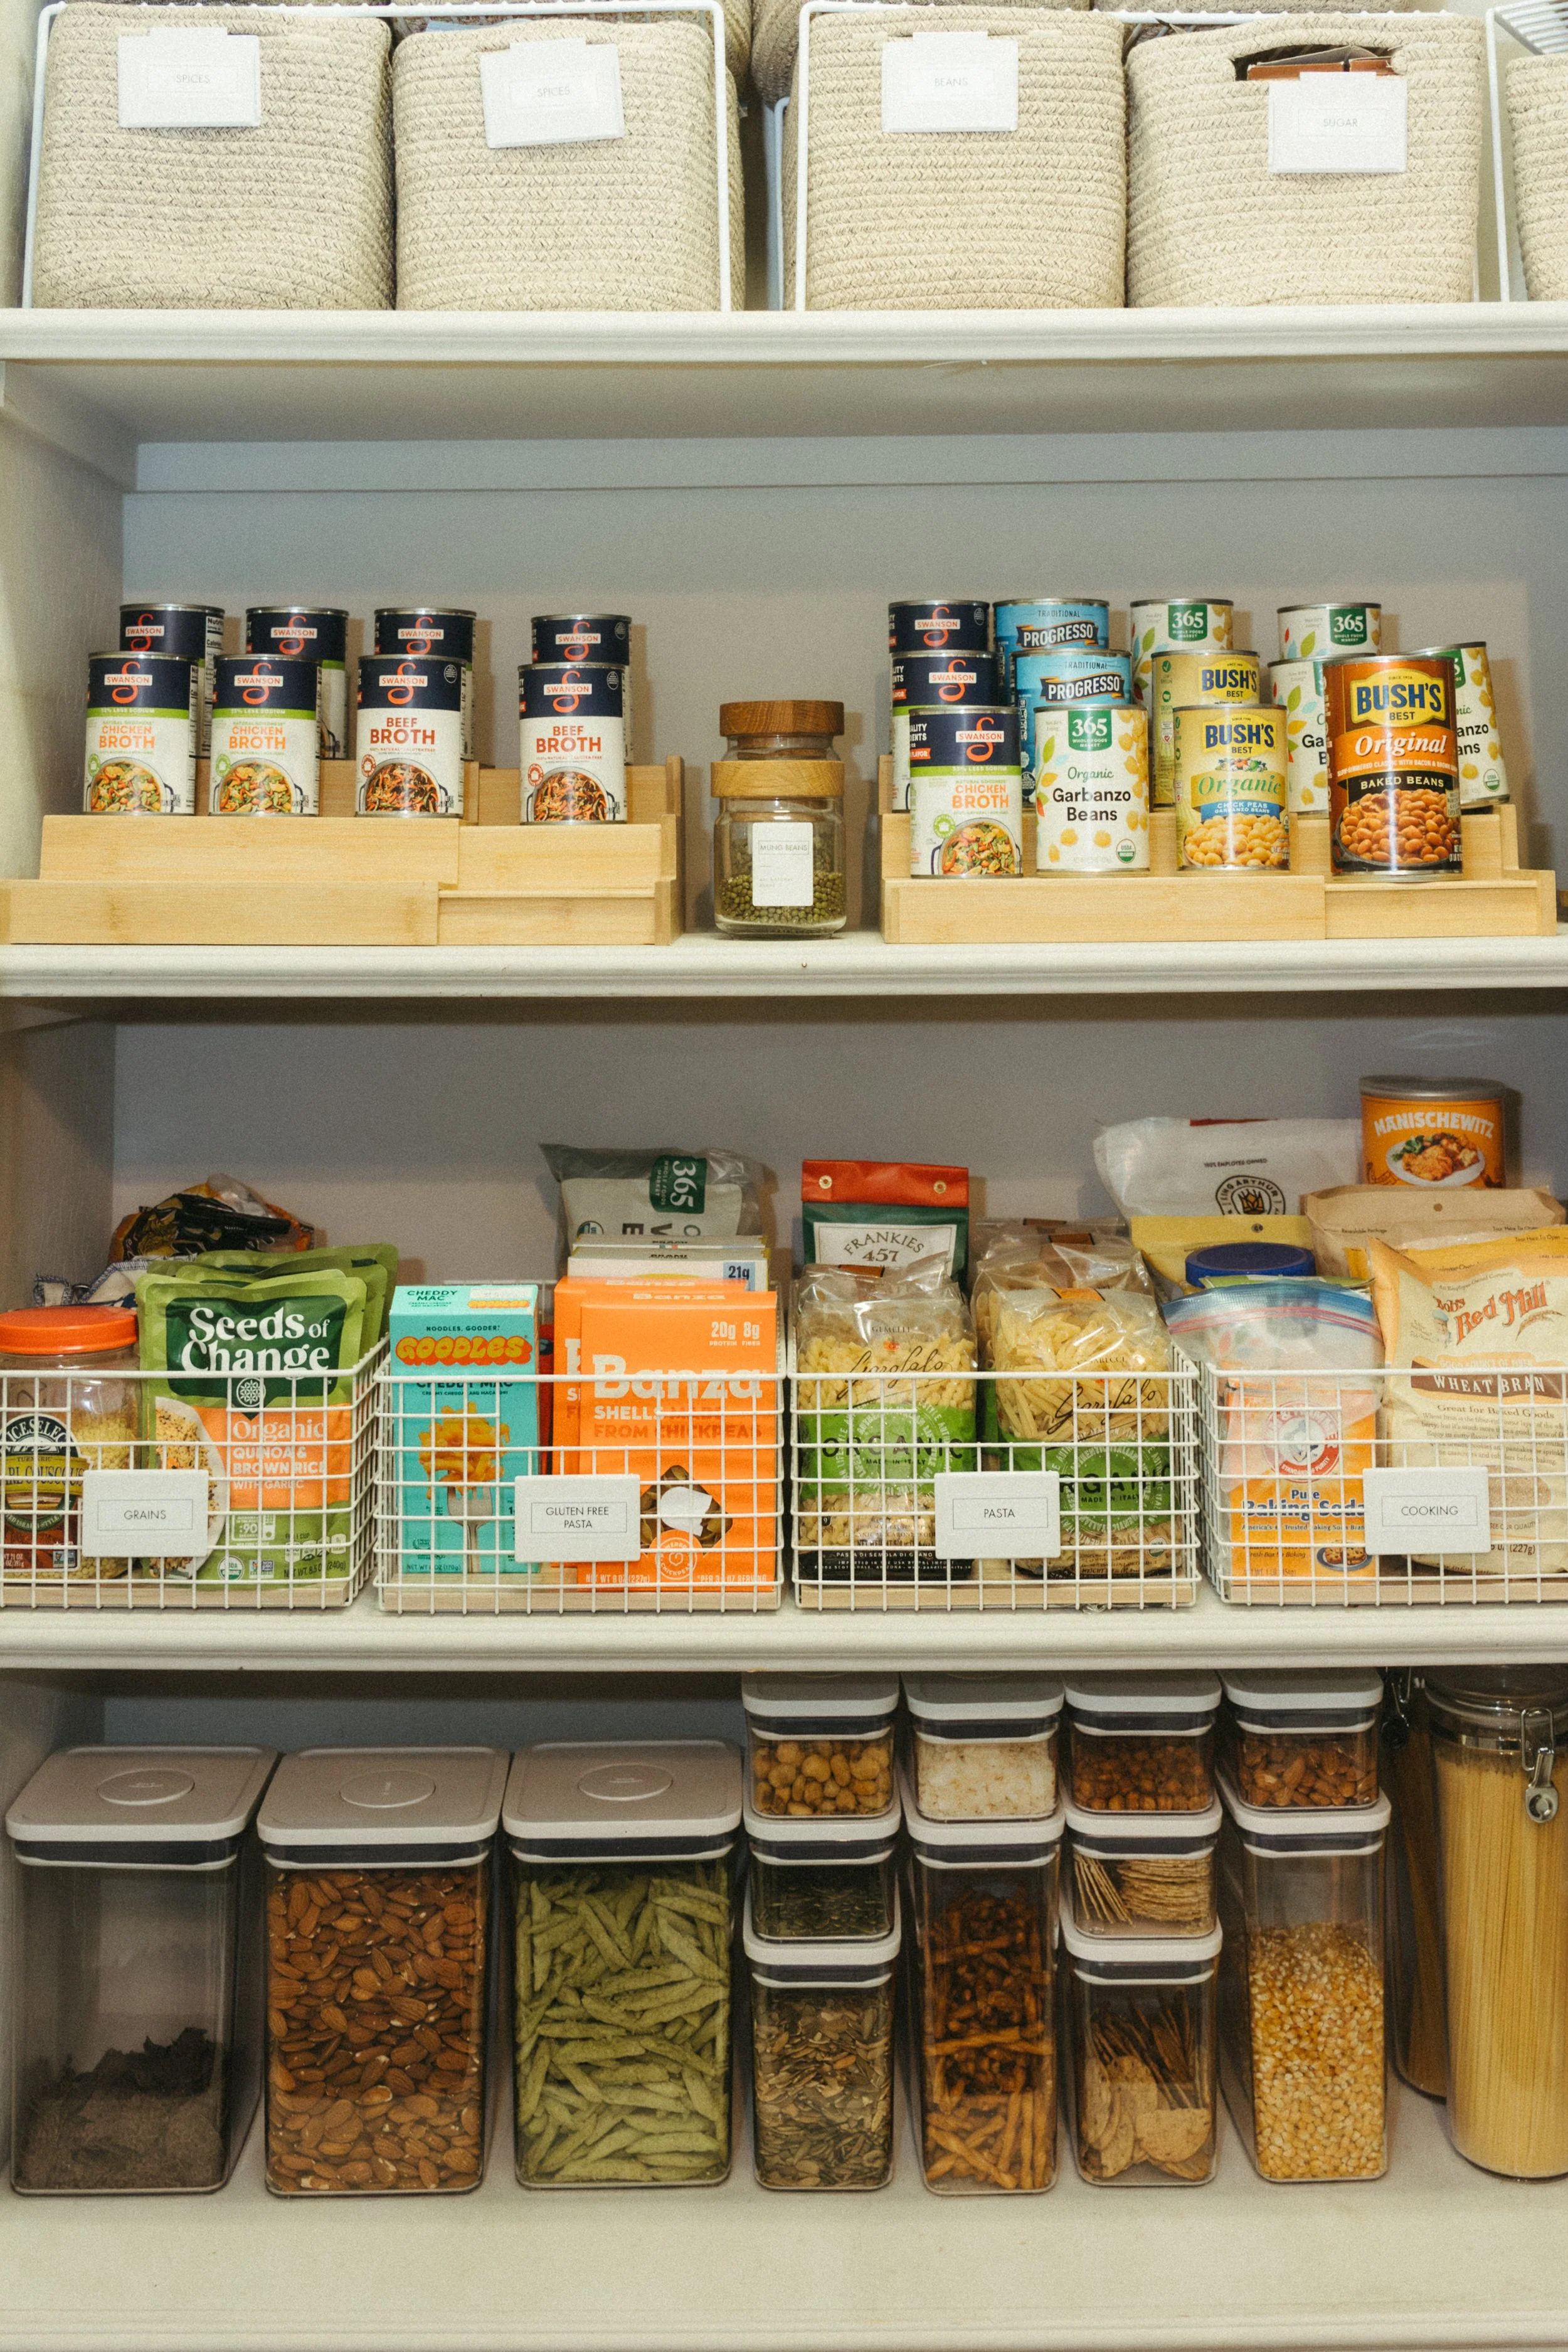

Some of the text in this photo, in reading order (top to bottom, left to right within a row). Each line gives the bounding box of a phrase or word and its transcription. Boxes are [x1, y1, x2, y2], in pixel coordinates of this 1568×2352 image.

[176, 74, 210, 83] SPICES
[935, 78, 968, 87] BEANS
[538, 86, 569, 97] SPICES
[1323, 118, 1358, 127] SUGAR
[1172, 610, 1204, 628] 365
[1334, 614, 1364, 632] 365
[1024, 623, 1093, 647] PROGRESSO
[1049, 675, 1120, 700] PROGRESSO
[1201, 669, 1257, 692] BUSH'S
[1357, 683, 1441, 716] BUSH'S
[386, 717, 417, 728] BEEF
[1389, 711, 1415, 720] BEST
[102, 725, 152, 734] CHICKEN
[232, 726, 283, 735] CHICKEN
[553, 725, 584, 736] BEEF
[1071, 716, 1108, 737] 365
[1457, 724, 1489, 738] anzo
[99, 735, 156, 748] BROTH
[229, 736, 286, 750] BROTH
[370, 728, 435, 745] BROTH
[1205, 724, 1274, 749] BUSH'S
[1355, 732, 1447, 756] Original
[536, 737, 601, 753] BROTH
[1457, 744, 1481, 756] ans
[1067, 766, 1114, 783] Organic
[955, 785, 1006, 793] CHICKEN
[1198, 775, 1281, 796] Organic
[1360, 776, 1444, 790] BAKED BEANS
[952, 795, 1009, 808] BROTH
[1053, 787, 1131, 802] Garbanzo
[1067, 807, 1118, 821] Beans
[1374, 1112, 1495, 1139] MANISCHEWITZ
[670, 1160, 697, 1207] 365
[1236, 1179, 1279, 1197] ARTHUR
[844, 1231, 924, 1255] FRANKIES
[862, 1249, 899, 1263] 457
[728, 1266, 750, 1280] 21g
[1454, 1295, 1500, 1345] Red
[1498, 1281, 1548, 1327] Mill
[189, 1306, 330, 1343] Seeds of
[711, 1322, 760, 1339] 20g 8g
[396, 1336, 529, 1364] GOODLES
[181, 1340, 330, 1380] Change
[593, 1354, 763, 1399] Banza
[1433, 1374, 1545, 1394] WHEAT BRAN
[594, 1405, 664, 1421] SHELLS
[1438, 1404, 1466, 1412] Great
[1470, 1406, 1483, 1414] for
[1522, 1409, 1555, 1419] Gods
[5, 1419, 70, 1441] ICESELEC
[233, 1419, 326, 1441] Organic
[594, 1424, 763, 1439] FROM CHICKPEAS
[233, 1446, 307, 1459] QUINOA &
[822, 1435, 963, 1459] ORGANIC
[233, 1461, 326, 1475] BROWN RICE
[233, 1480, 304, 1490] WITH GARLC
[1060, 1466, 1170, 1493] RGANIC
[1291, 1489, 1320, 1499] Pue
[124, 1510, 166, 1520] GRAINS
[546, 1507, 609, 1515] GLUTEN FREE
[984, 1508, 1015, 1518] PASTA
[1242, 1499, 1365, 1522] Baking Soda
[1401, 1506, 1458, 1516] COOKING
[564, 1520, 593, 1528] PASTA
[1510, 1544, 1536, 1556] (227g)
[326, 1560, 346, 1571] (240g)
[586, 1574, 650, 1584] NT WT 8 (227g)
